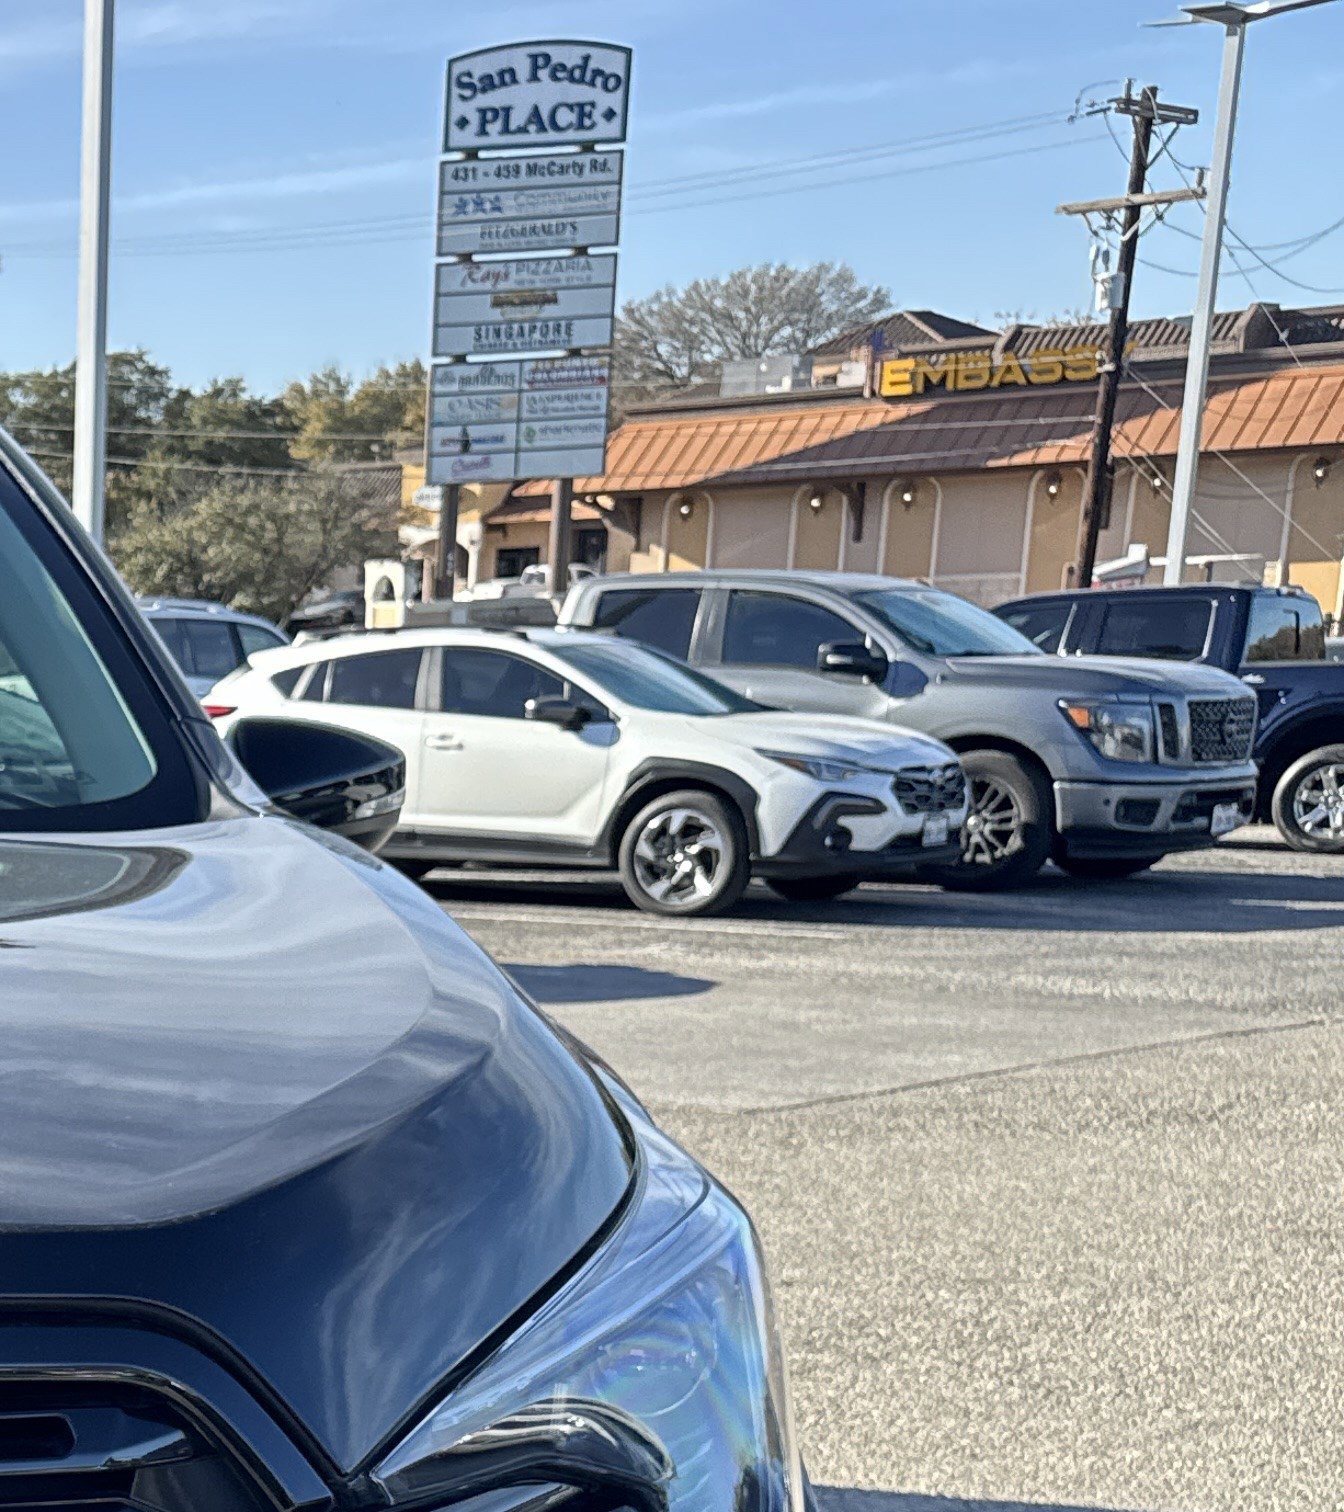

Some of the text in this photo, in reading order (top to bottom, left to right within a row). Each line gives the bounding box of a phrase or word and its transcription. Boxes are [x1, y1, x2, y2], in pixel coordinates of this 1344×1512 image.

[455, 52, 622, 101] San Pedro
[475, 101, 597, 137] PLACE
[451, 167, 478, 182] 431
[525, 160, 585, 178] McCarty
[474, 321, 574, 343] SINGAPORE
[880, 340, 1138, 397] EMBASS
